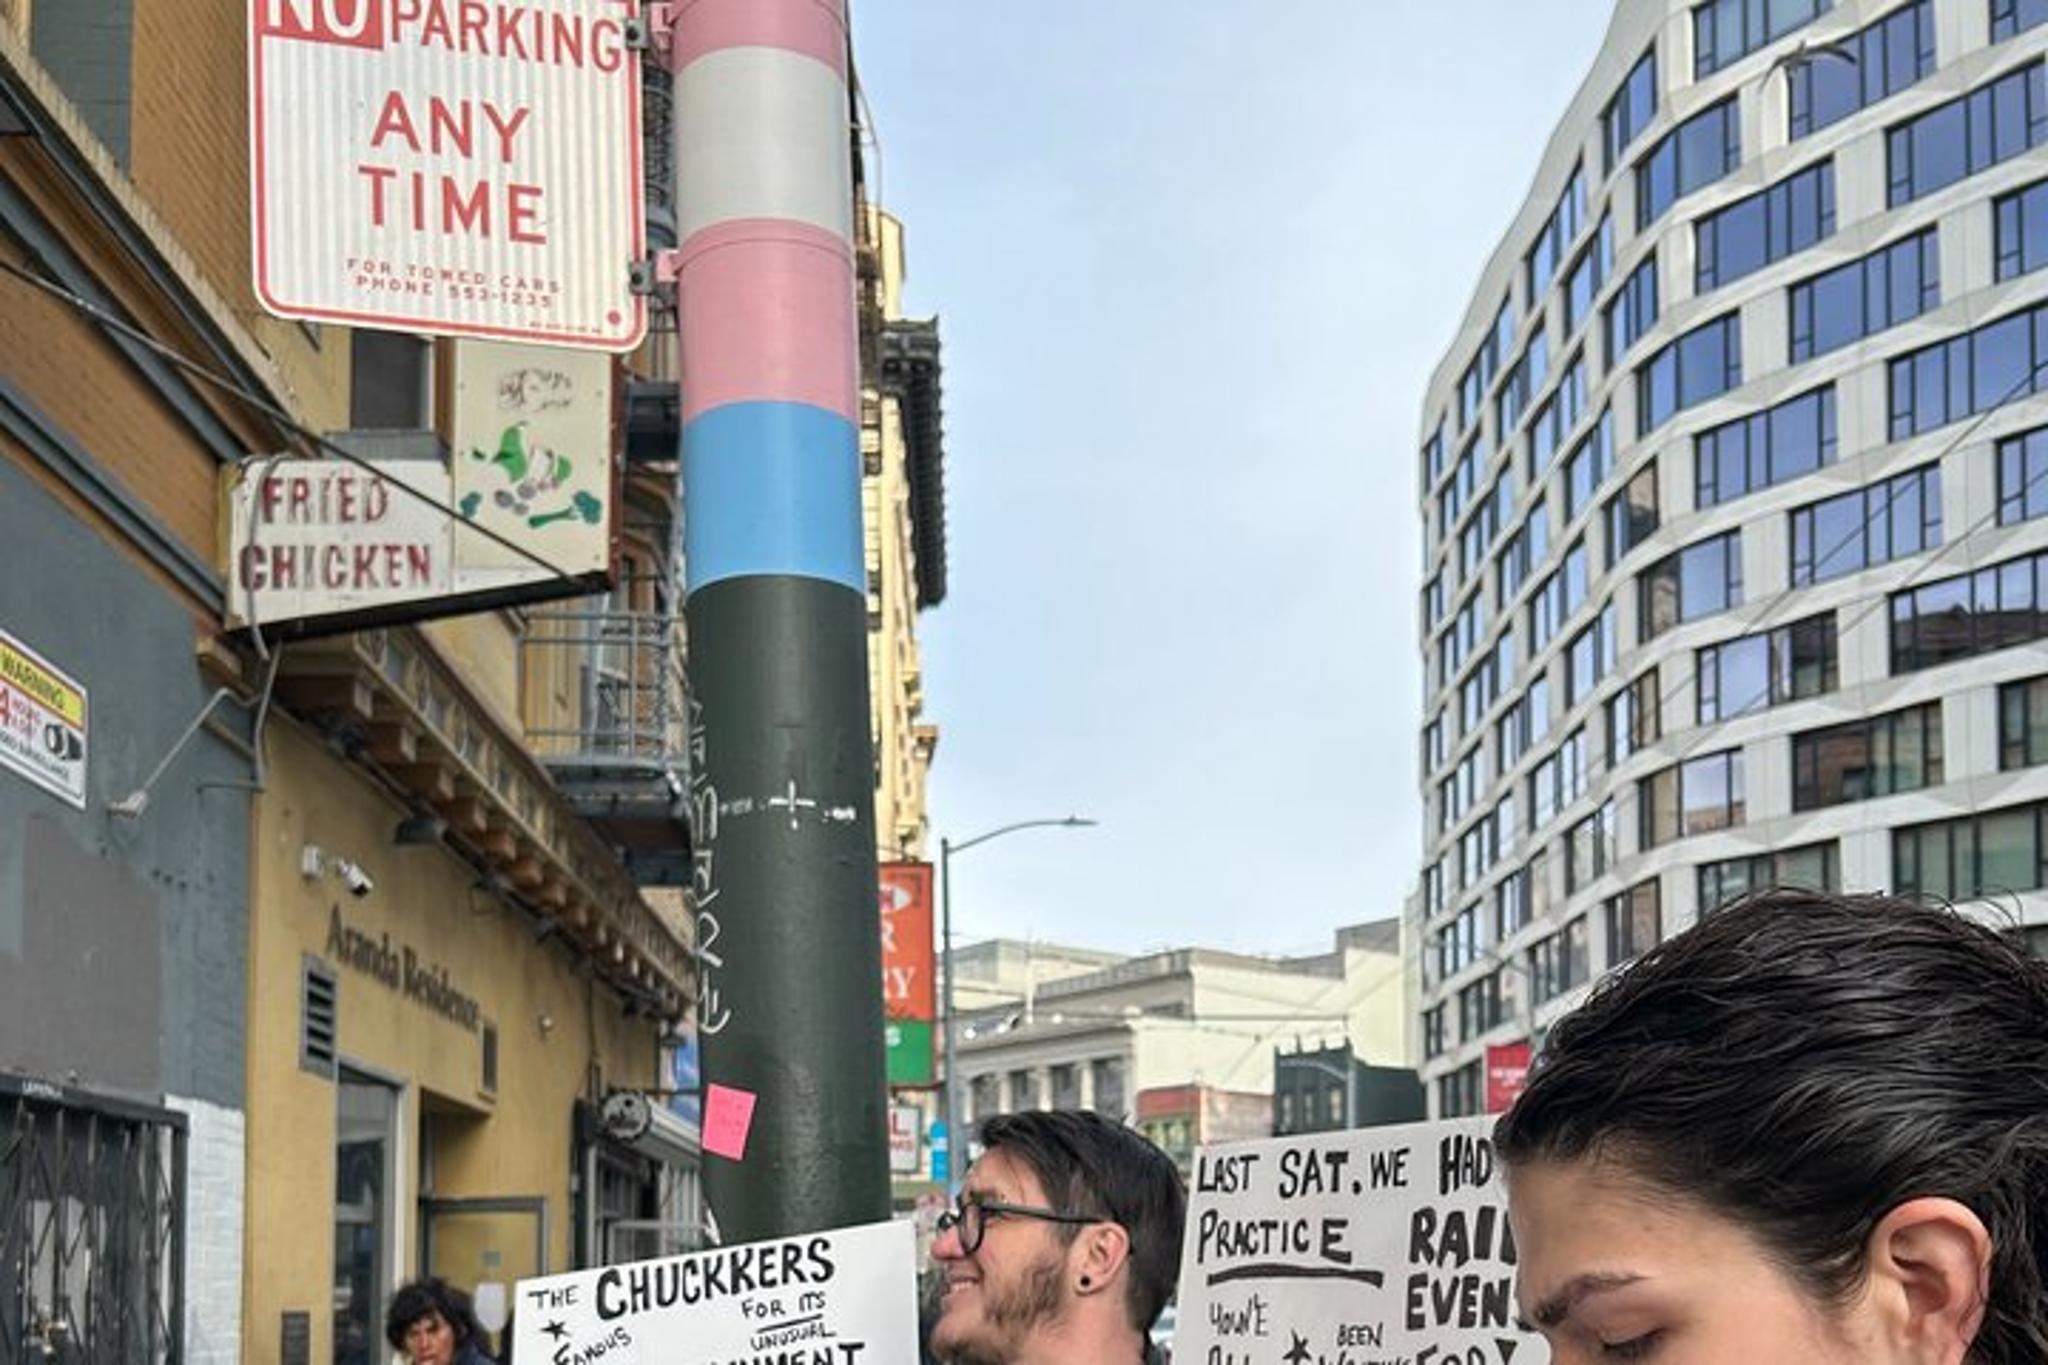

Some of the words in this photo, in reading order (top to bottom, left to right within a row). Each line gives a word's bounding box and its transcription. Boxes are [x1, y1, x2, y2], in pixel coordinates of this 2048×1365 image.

[391, 0, 622, 73] PARKING
[371, 90, 530, 163] ANY
[358, 166, 547, 245] TIME
[347, 258, 390, 274] FOR
[407, 264, 487, 285] TOWED
[500, 275, 559, 293] CARS
[356, 275, 432, 296] PHONE
[262, 476, 388, 523] FRIED
[239, 544, 431, 592] CHICKEN
[325, 902, 399, 991] Aranda
[1197, 1153, 1260, 1194] LAST
[1279, 1148, 1362, 1199] SAT.
[1371, 1147, 1410, 1189] WE
[1440, 1134, 1492, 1195] HAD
[1197, 1208, 1352, 1264] PRACTICE
[528, 1284, 579, 1310] THE
[596, 1237, 835, 1321] CHUCKKERS
[742, 1297, 786, 1319] FOR
[799, 1291, 826, 1313] ITS
[1406, 1273, 1511, 1331] EVEN
[750, 1322, 837, 1351] UNUSUAL
[1337, 1321, 1383, 1348] BEEN
